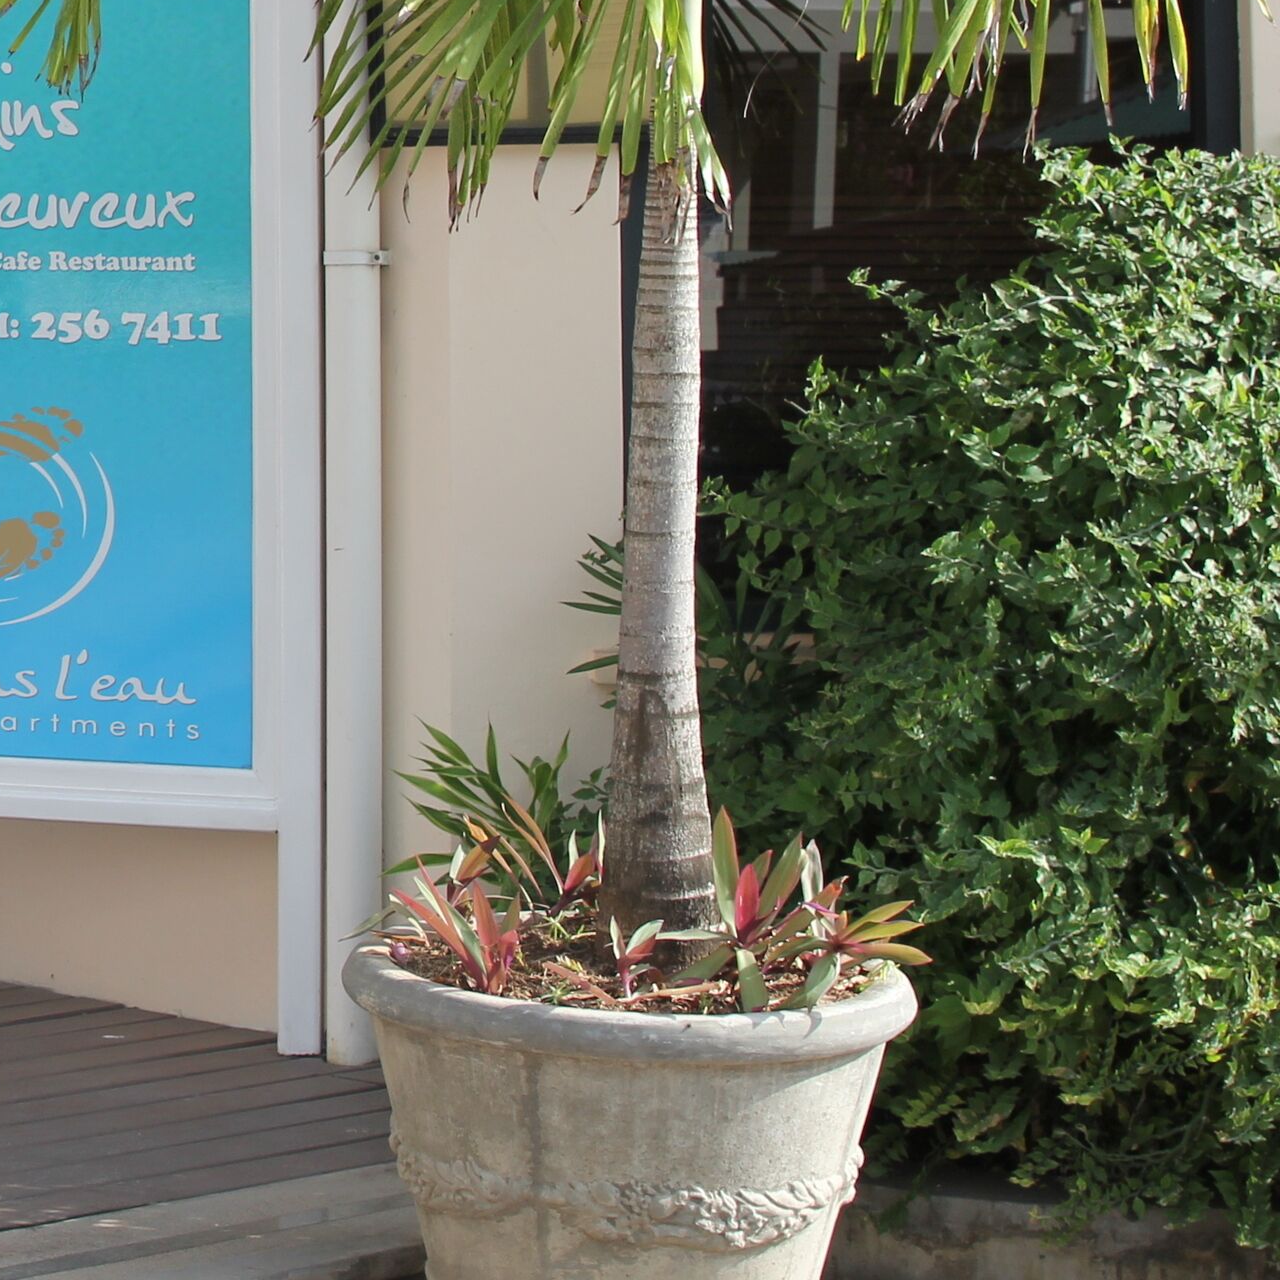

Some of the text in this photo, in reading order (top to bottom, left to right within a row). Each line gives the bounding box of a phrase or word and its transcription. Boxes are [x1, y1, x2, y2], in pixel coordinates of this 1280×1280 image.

[48, 250, 197, 273] Restaurant
[30, 310, 111, 345] 256
[120, 311, 224, 346] 7411
